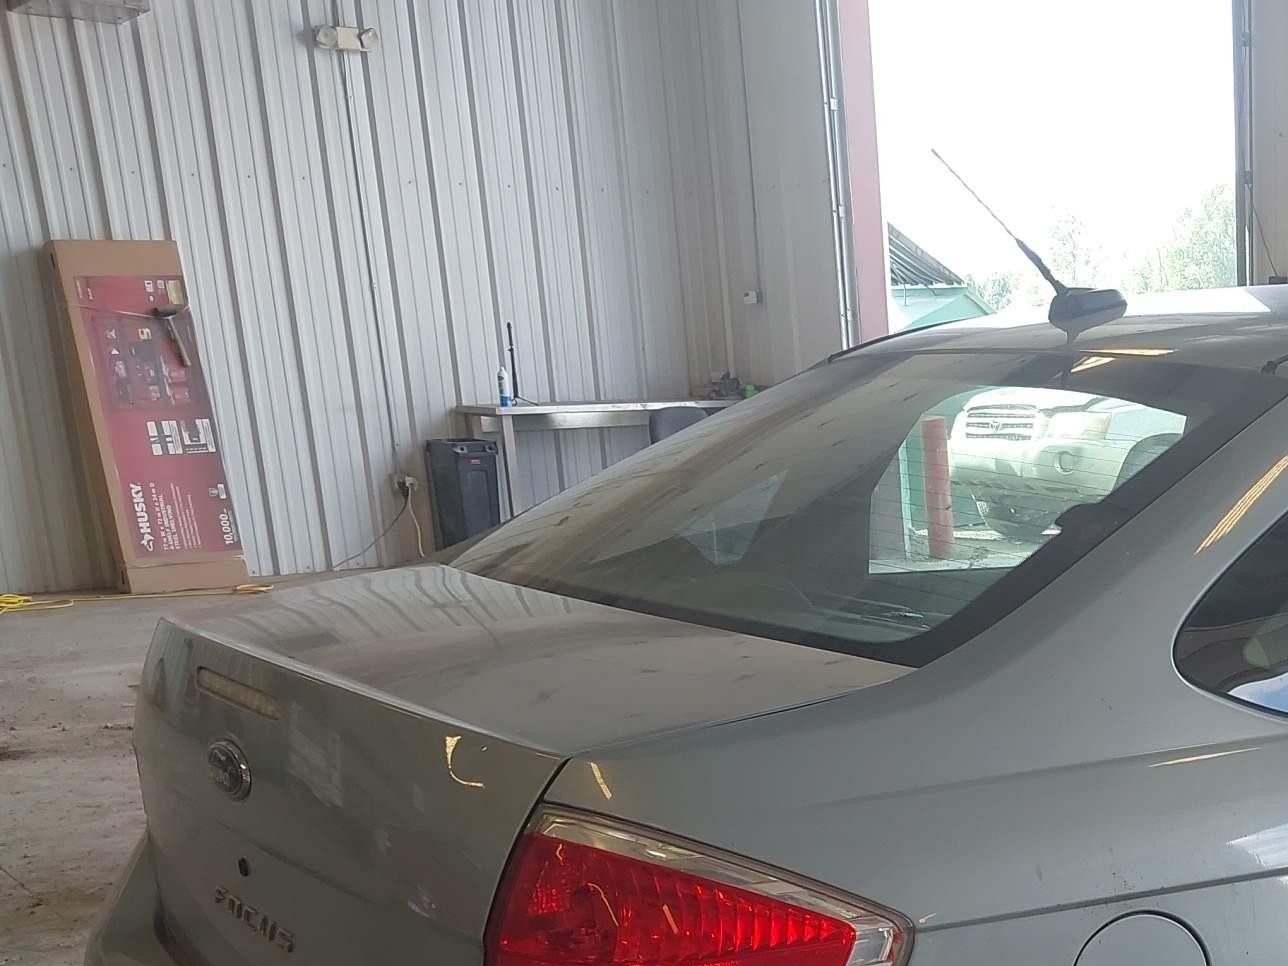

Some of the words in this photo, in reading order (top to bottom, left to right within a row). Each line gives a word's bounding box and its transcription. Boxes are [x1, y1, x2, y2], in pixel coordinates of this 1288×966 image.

[130, 483, 152, 533] HUSKY
[219, 513, 234, 544] 10,000
[214, 886, 295, 953] FOCUS
